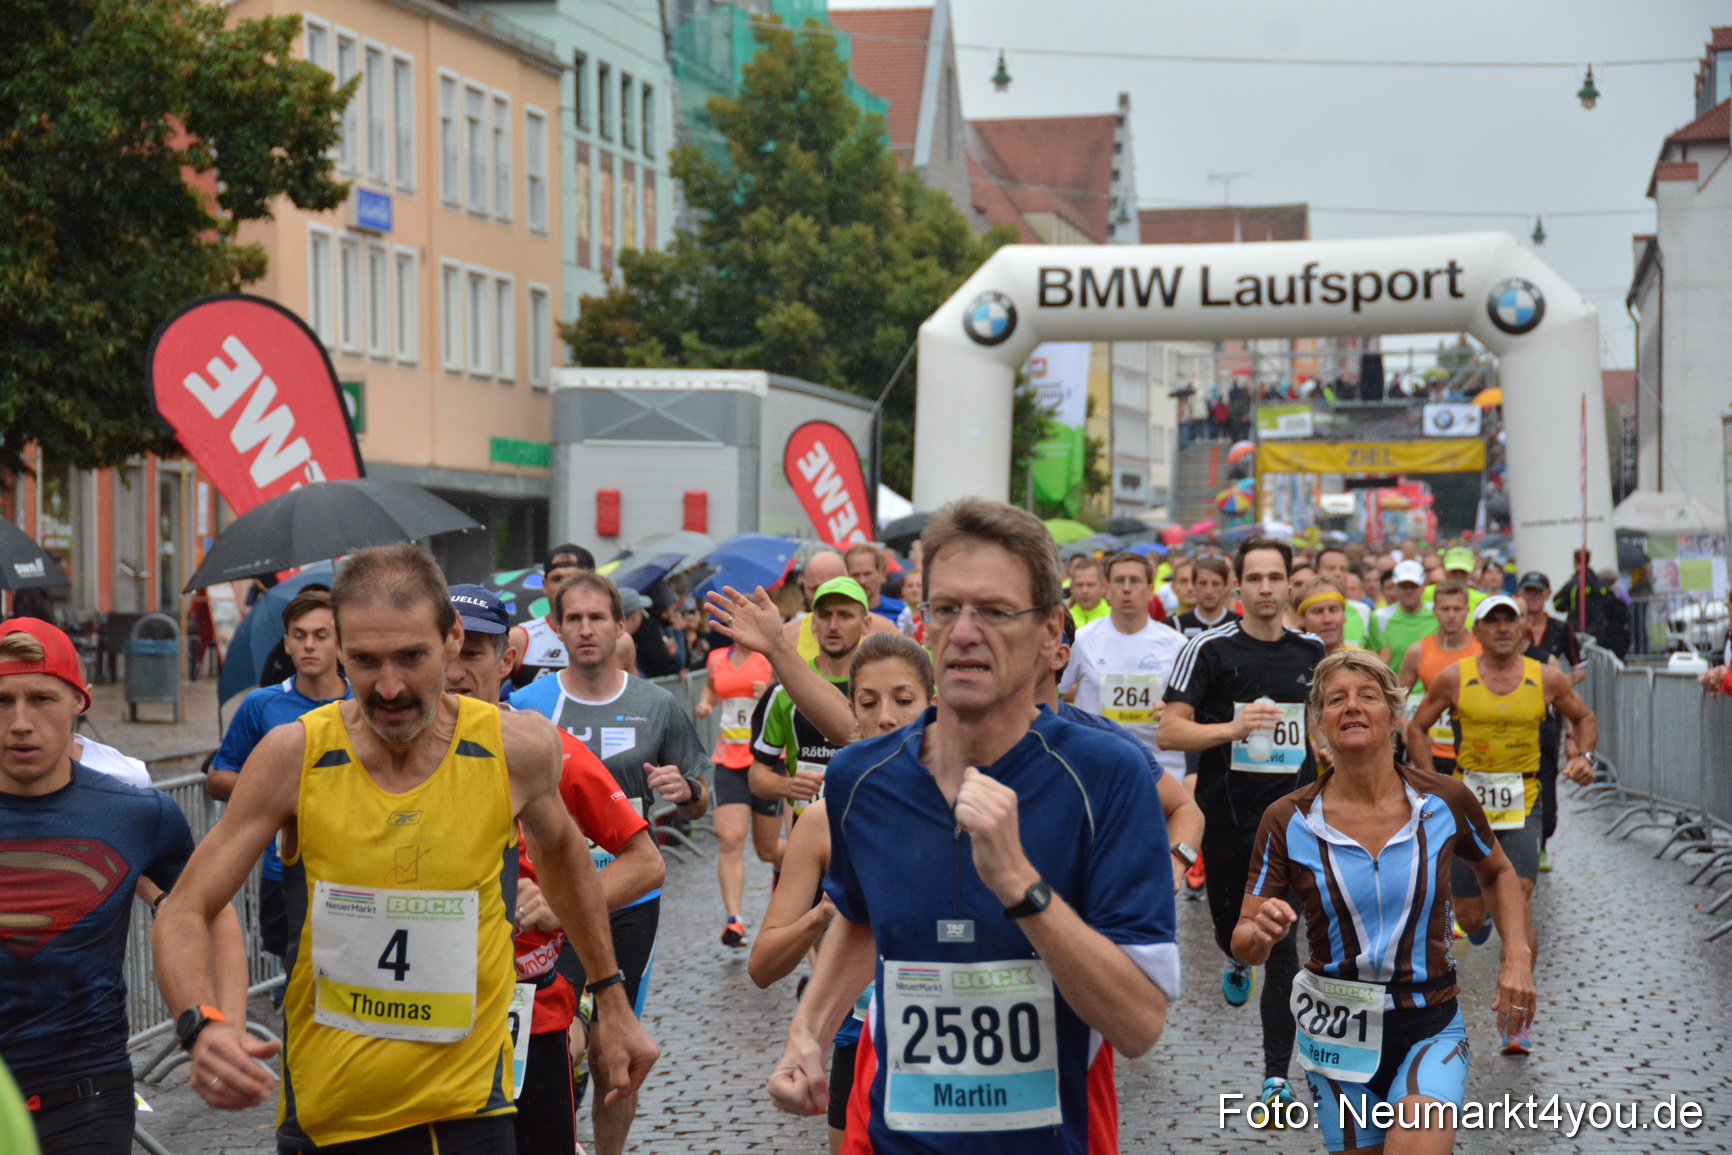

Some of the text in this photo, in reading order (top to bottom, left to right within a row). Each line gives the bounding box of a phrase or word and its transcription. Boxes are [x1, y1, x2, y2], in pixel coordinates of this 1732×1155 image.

[1037, 259, 1465, 313] BMW Laufsport
[1346, 447, 1397, 467] ZIEL
[1112, 686, 1151, 707] 264
[801, 746, 842, 758] Röthe
[1476, 786, 1512, 808] 319
[325, 901, 377, 914] NeuerMarkt
[386, 896, 465, 915] BOCK
[377, 929, 411, 982] 4
[951, 966, 1036, 990] BOCK
[1323, 981, 1374, 1001] BOCK
[349, 992, 432, 1021] Thomas
[1296, 992, 1368, 1043] 2801
[902, 1002, 1041, 1066] 2580
[1309, 1043, 1340, 1065] Petra
[933, 1083, 1008, 1107] Martin
